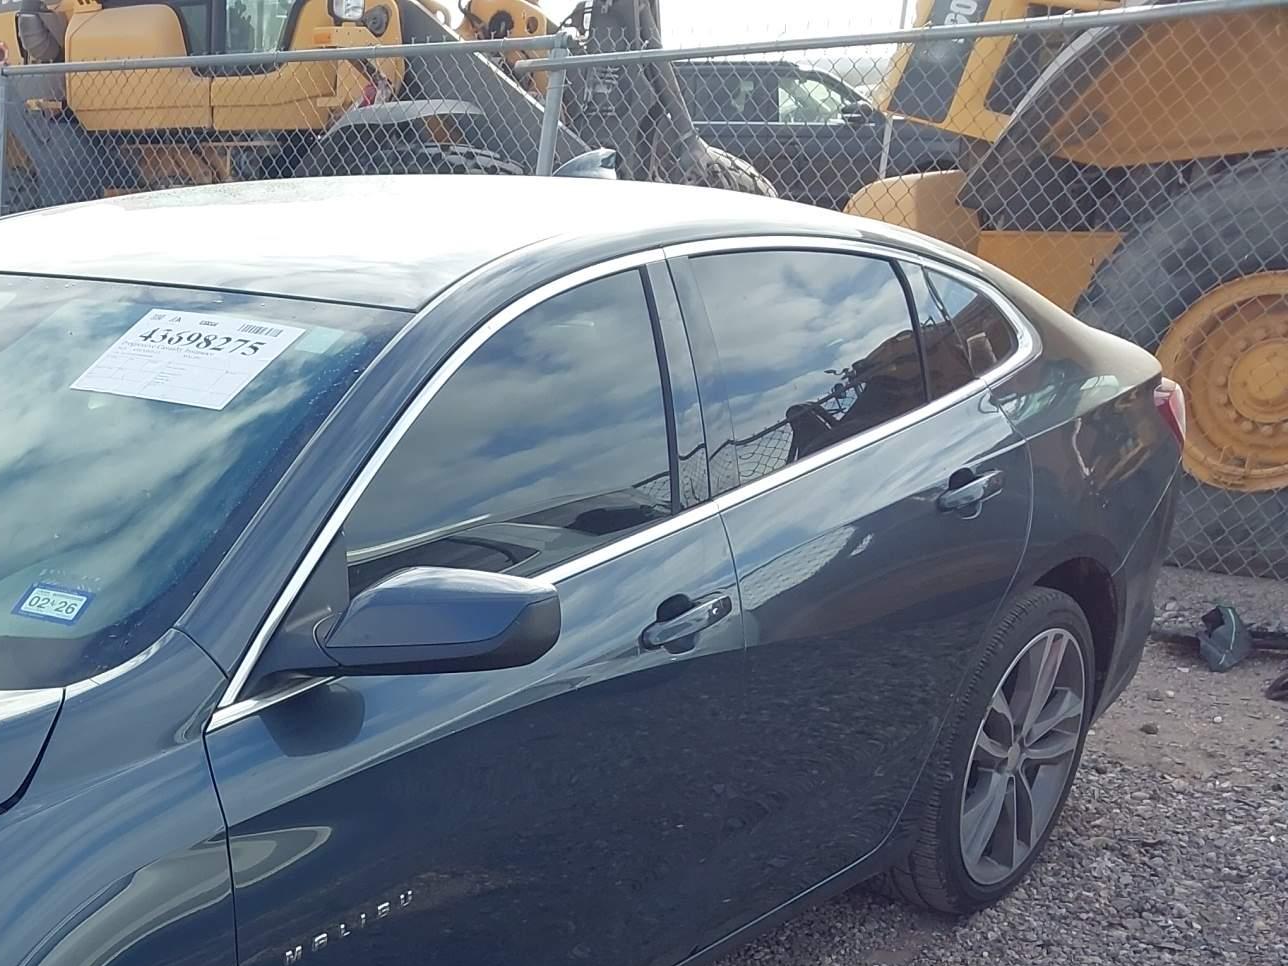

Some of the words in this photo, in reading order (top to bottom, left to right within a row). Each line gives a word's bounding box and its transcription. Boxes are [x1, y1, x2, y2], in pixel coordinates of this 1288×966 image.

[28, 595, 51, 609] 02
[54, 600, 78, 614] 26
[284, 890, 412, 966] MALIBU
